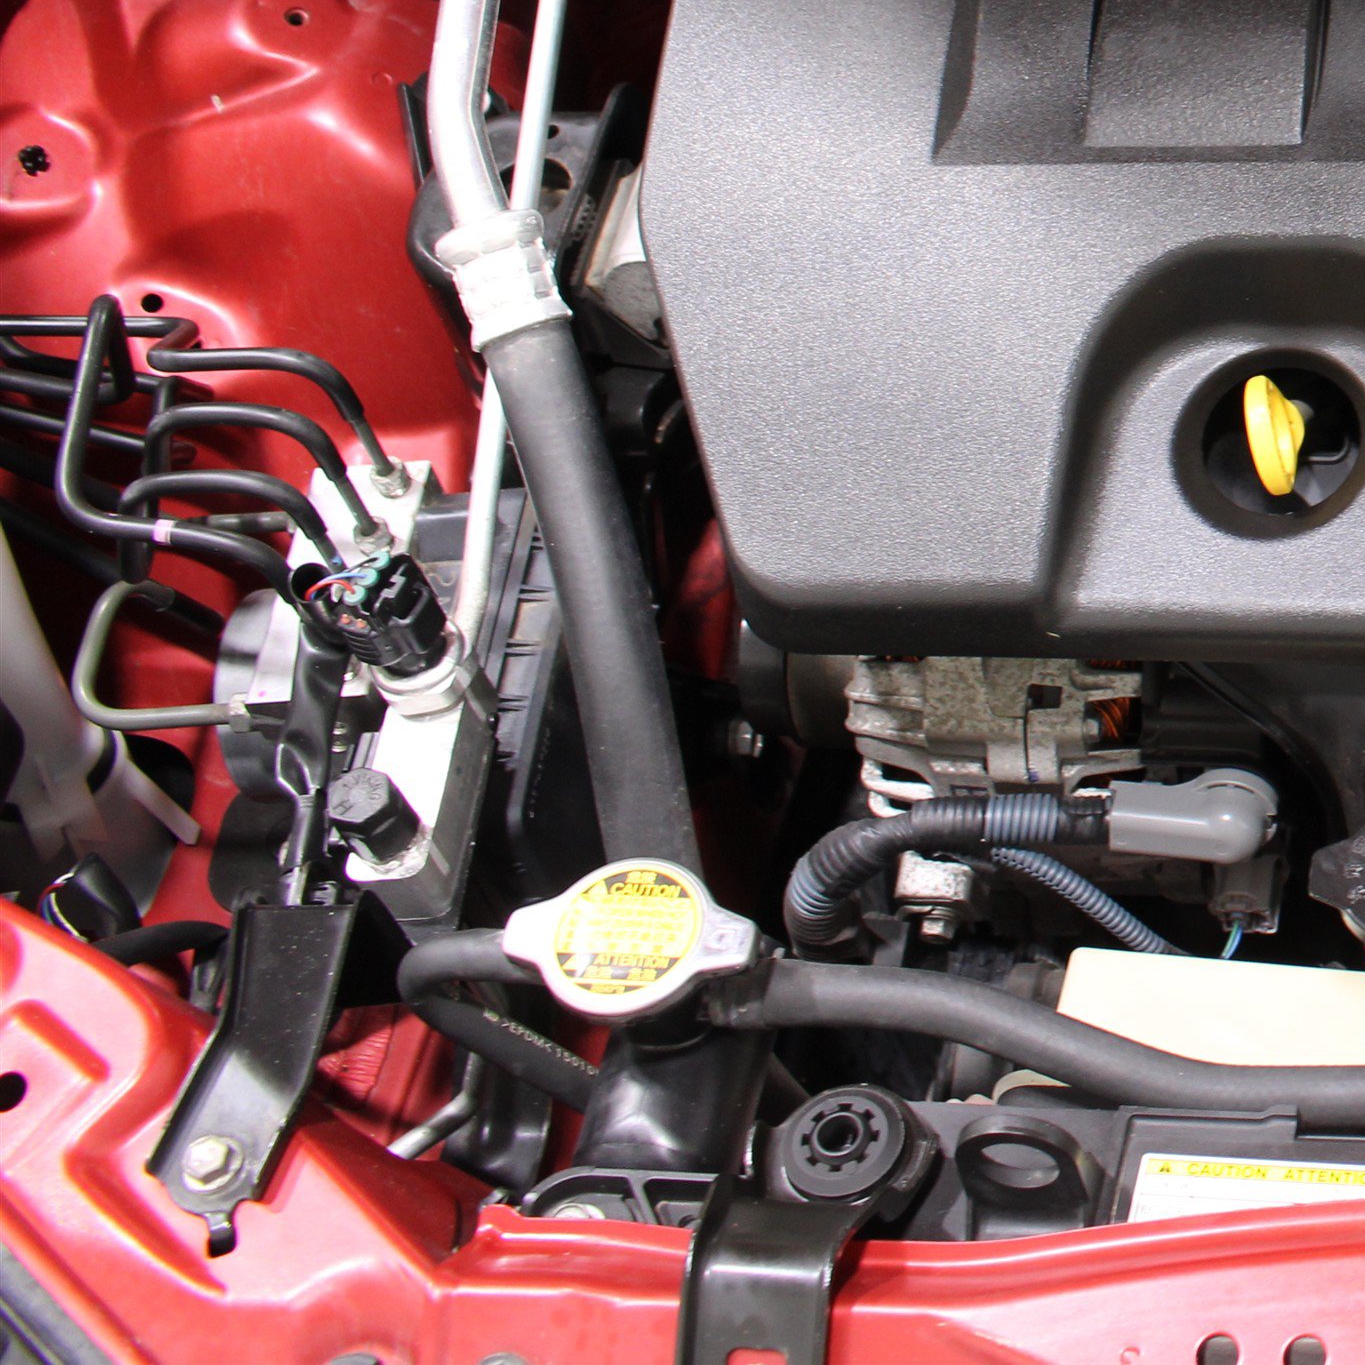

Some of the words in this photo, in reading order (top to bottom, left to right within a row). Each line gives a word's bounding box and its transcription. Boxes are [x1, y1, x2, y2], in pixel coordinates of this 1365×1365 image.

[610, 883, 681, 898] CAUTION
[593, 953, 670, 968] ATTENTION
[1187, 1163, 1267, 1179] CAUTION
